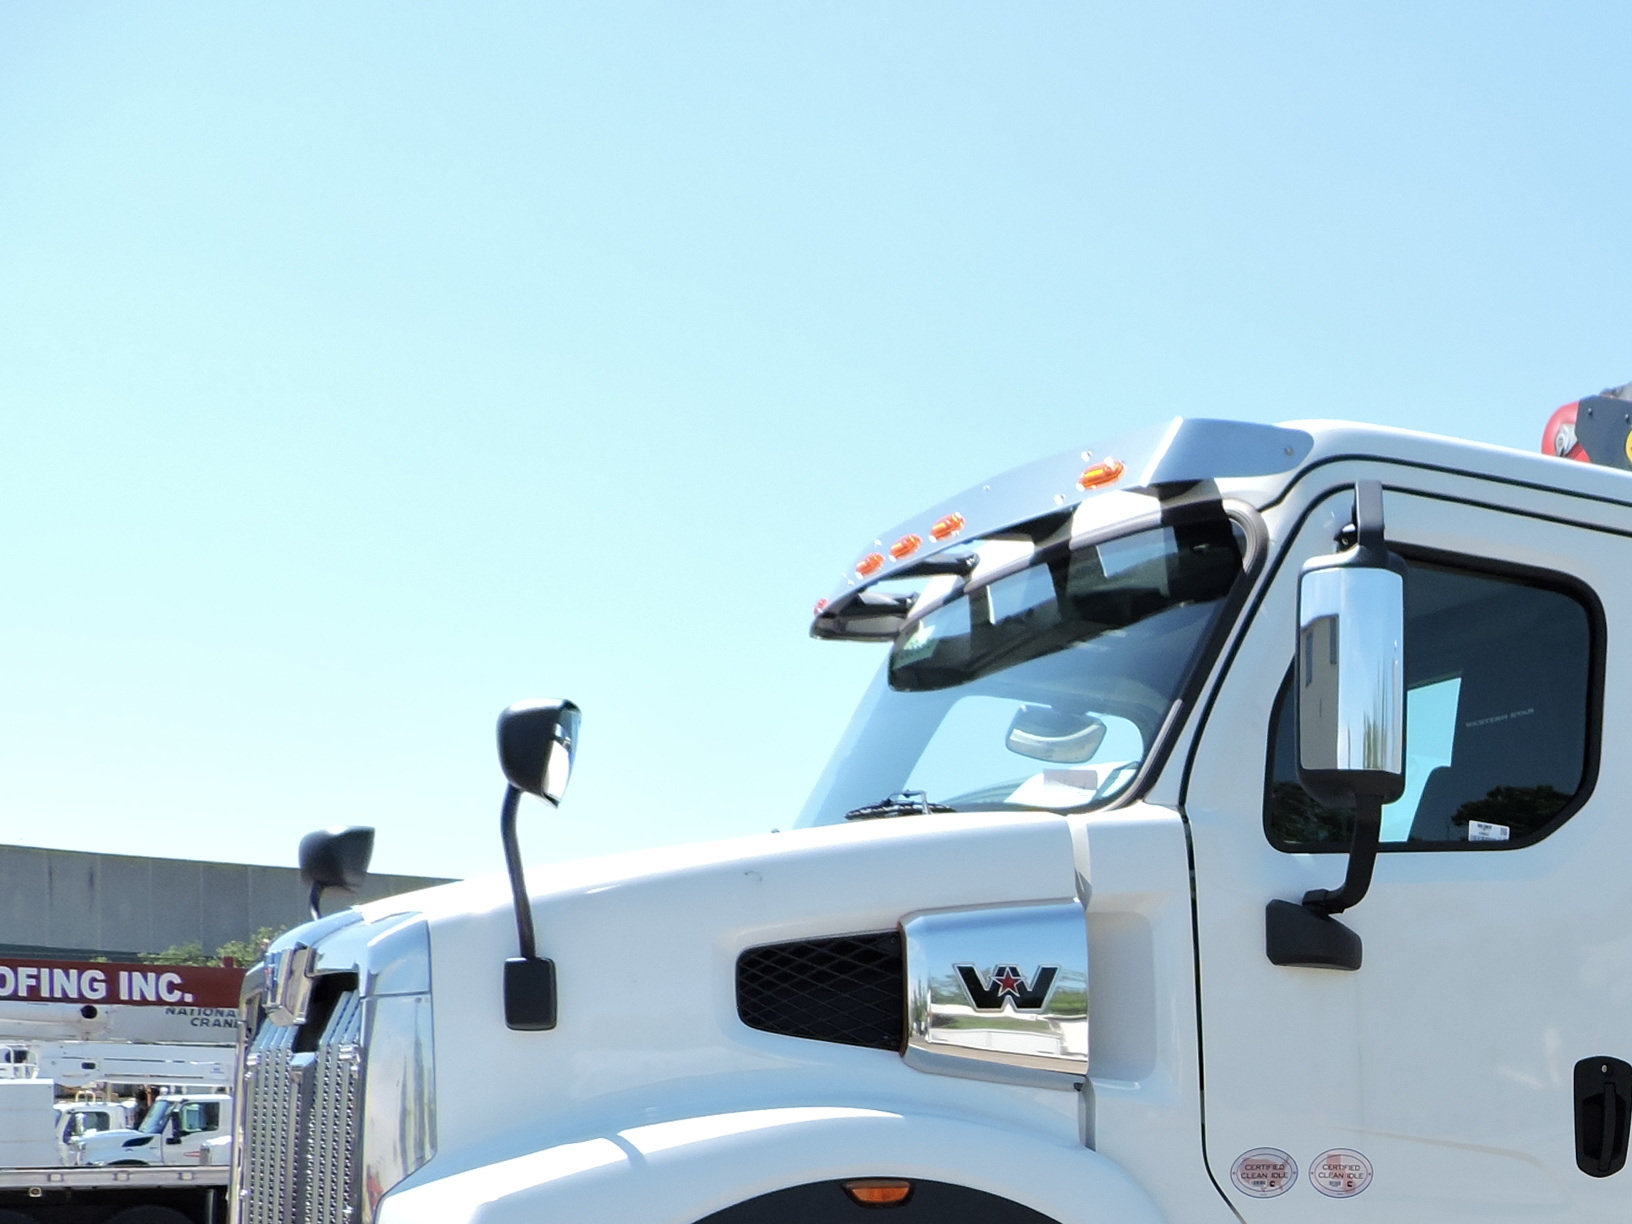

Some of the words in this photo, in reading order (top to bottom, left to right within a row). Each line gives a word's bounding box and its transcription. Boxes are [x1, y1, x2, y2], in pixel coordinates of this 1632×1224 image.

[118, 970, 194, 1003] INC.
[165, 1007, 239, 1018] NATIONA
[1244, 1163, 1286, 1171] CERTIFIED
[1321, 1163, 1361, 1171] CERTIFIED
[1240, 1171, 1268, 1180] CLEAN
[1270, 1171, 1289, 1180] IDLE
[1317, 1171, 1344, 1180] CLEAN
[1346, 1172, 1365, 1180] IDLE
